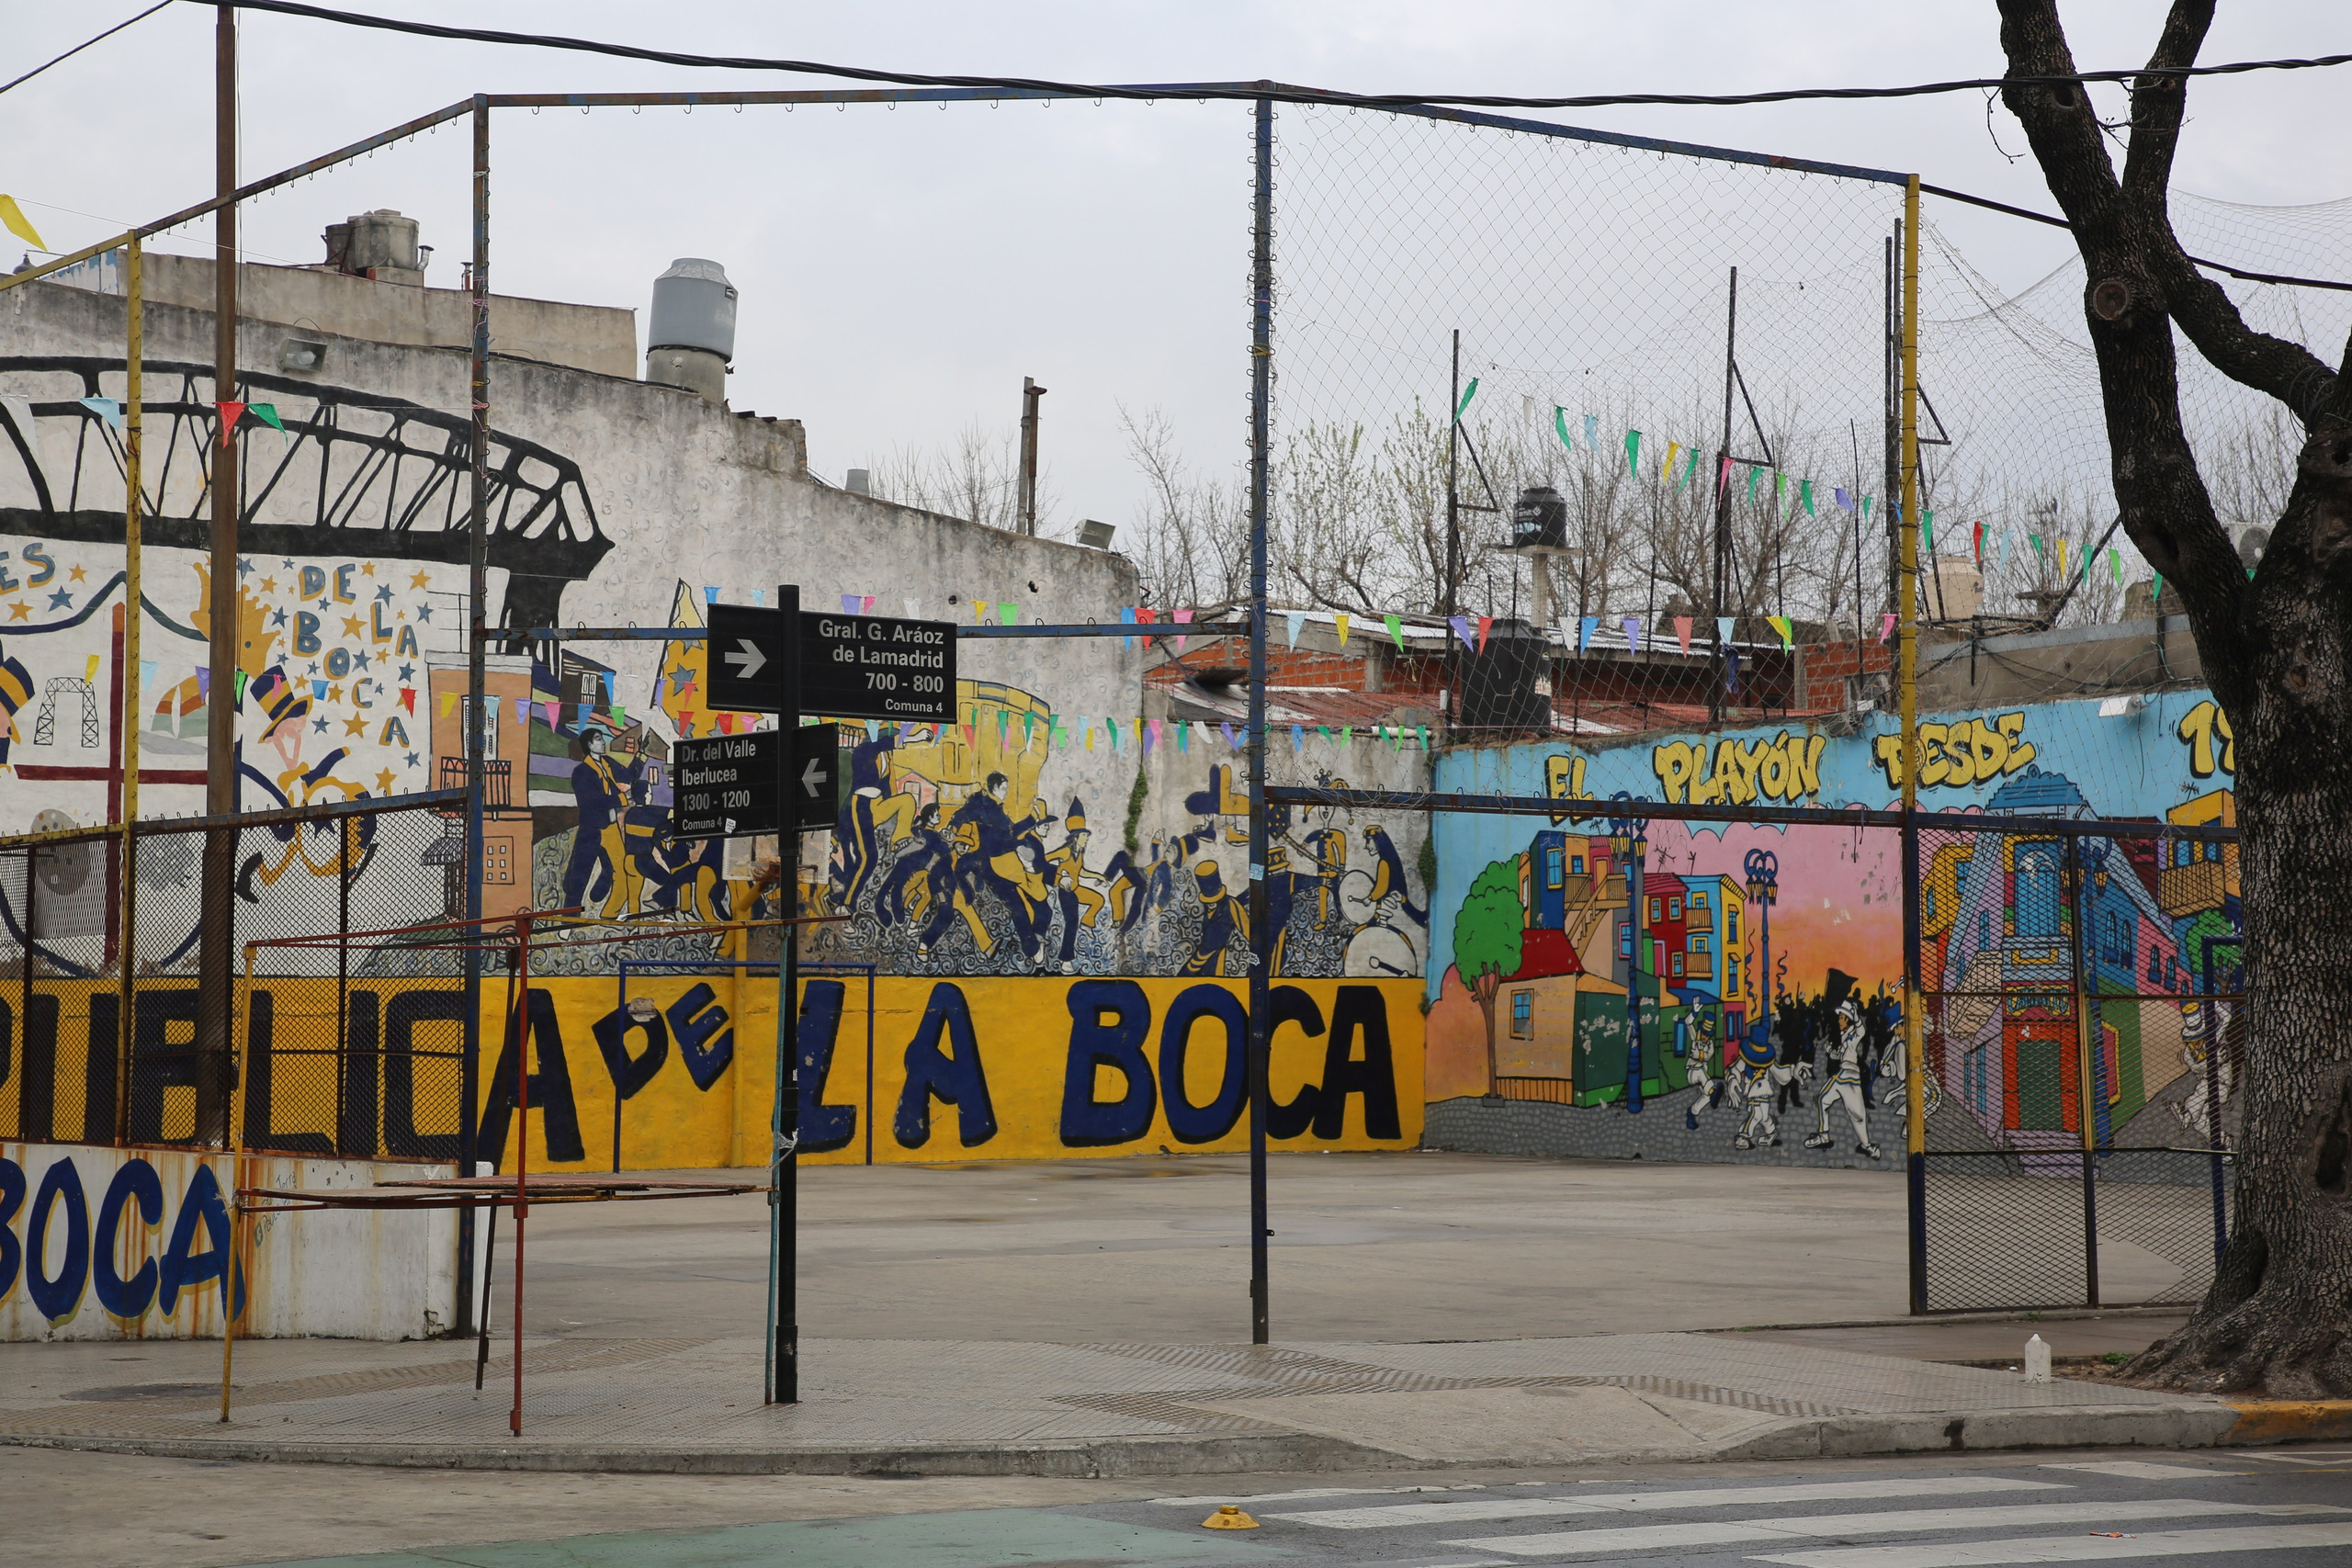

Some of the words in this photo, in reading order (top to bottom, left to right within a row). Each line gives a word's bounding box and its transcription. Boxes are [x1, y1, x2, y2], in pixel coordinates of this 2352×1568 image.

[299, 563, 357, 605] DE
[369, 601, 419, 660] LA
[819, 619, 862, 639] Gral.
[867, 623, 887, 641] G.
[892, 626, 944, 645] Aráoz
[832, 645, 855, 663] de
[860, 646, 944, 669] Lamadrid
[865, 672, 897, 691] 700
[912, 675, 944, 694] 800
[885, 698, 933, 713] Comuna
[935, 702, 944, 713] 4
[682, 745, 699, 763] Dr.
[703, 742, 721, 761] del
[725, 739, 756, 759] Valle
[682, 766, 738, 786] Iberlucea
[1544, 754, 1594, 827] EL
[1654, 728, 1826, 806] PLAYÓN
[1872, 711, 2036, 791] DESDE
[682, 793, 710, 811] 1300
[721, 790, 751, 808] 1200
[682, 818, 716, 830] Comuna
[717, 816, 723, 828] 4
[0, 987, 585, 1161] UBLICA
[592, 982, 734, 1100] DE
[771, 979, 999, 1154] LA
[1059, 979, 1402, 1148] BOCA
